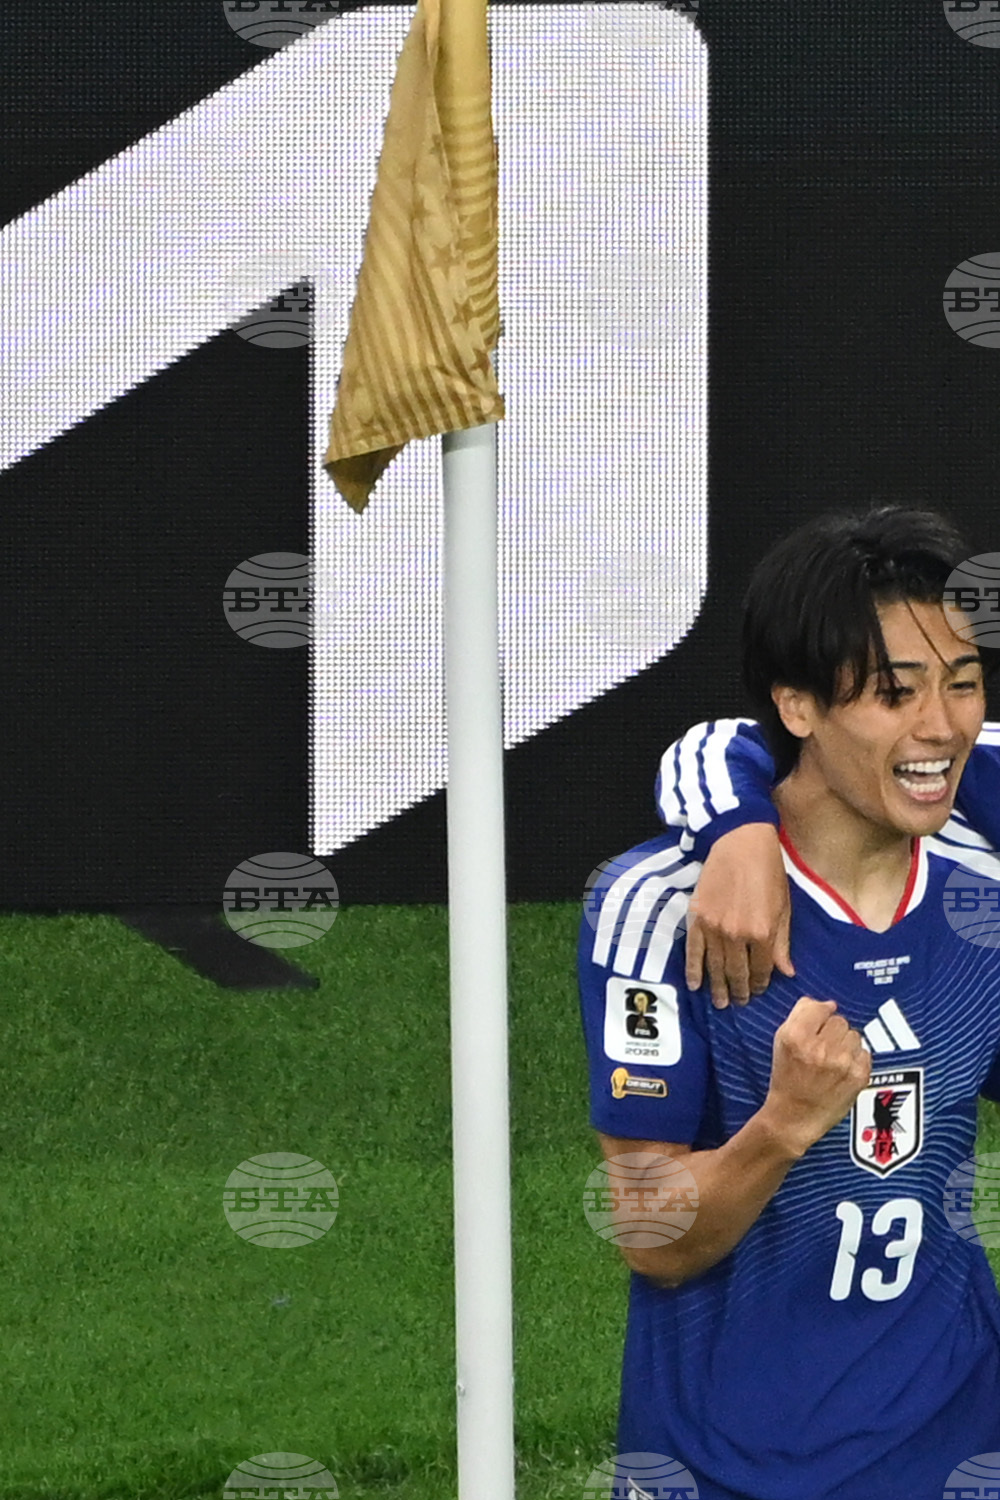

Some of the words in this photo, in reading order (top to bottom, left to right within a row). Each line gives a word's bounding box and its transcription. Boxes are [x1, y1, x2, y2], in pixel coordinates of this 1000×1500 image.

[625, 1047, 659, 1057] 2026
[868, 1140, 900, 1159] JFA
[829, 1198, 923, 1302] 13
